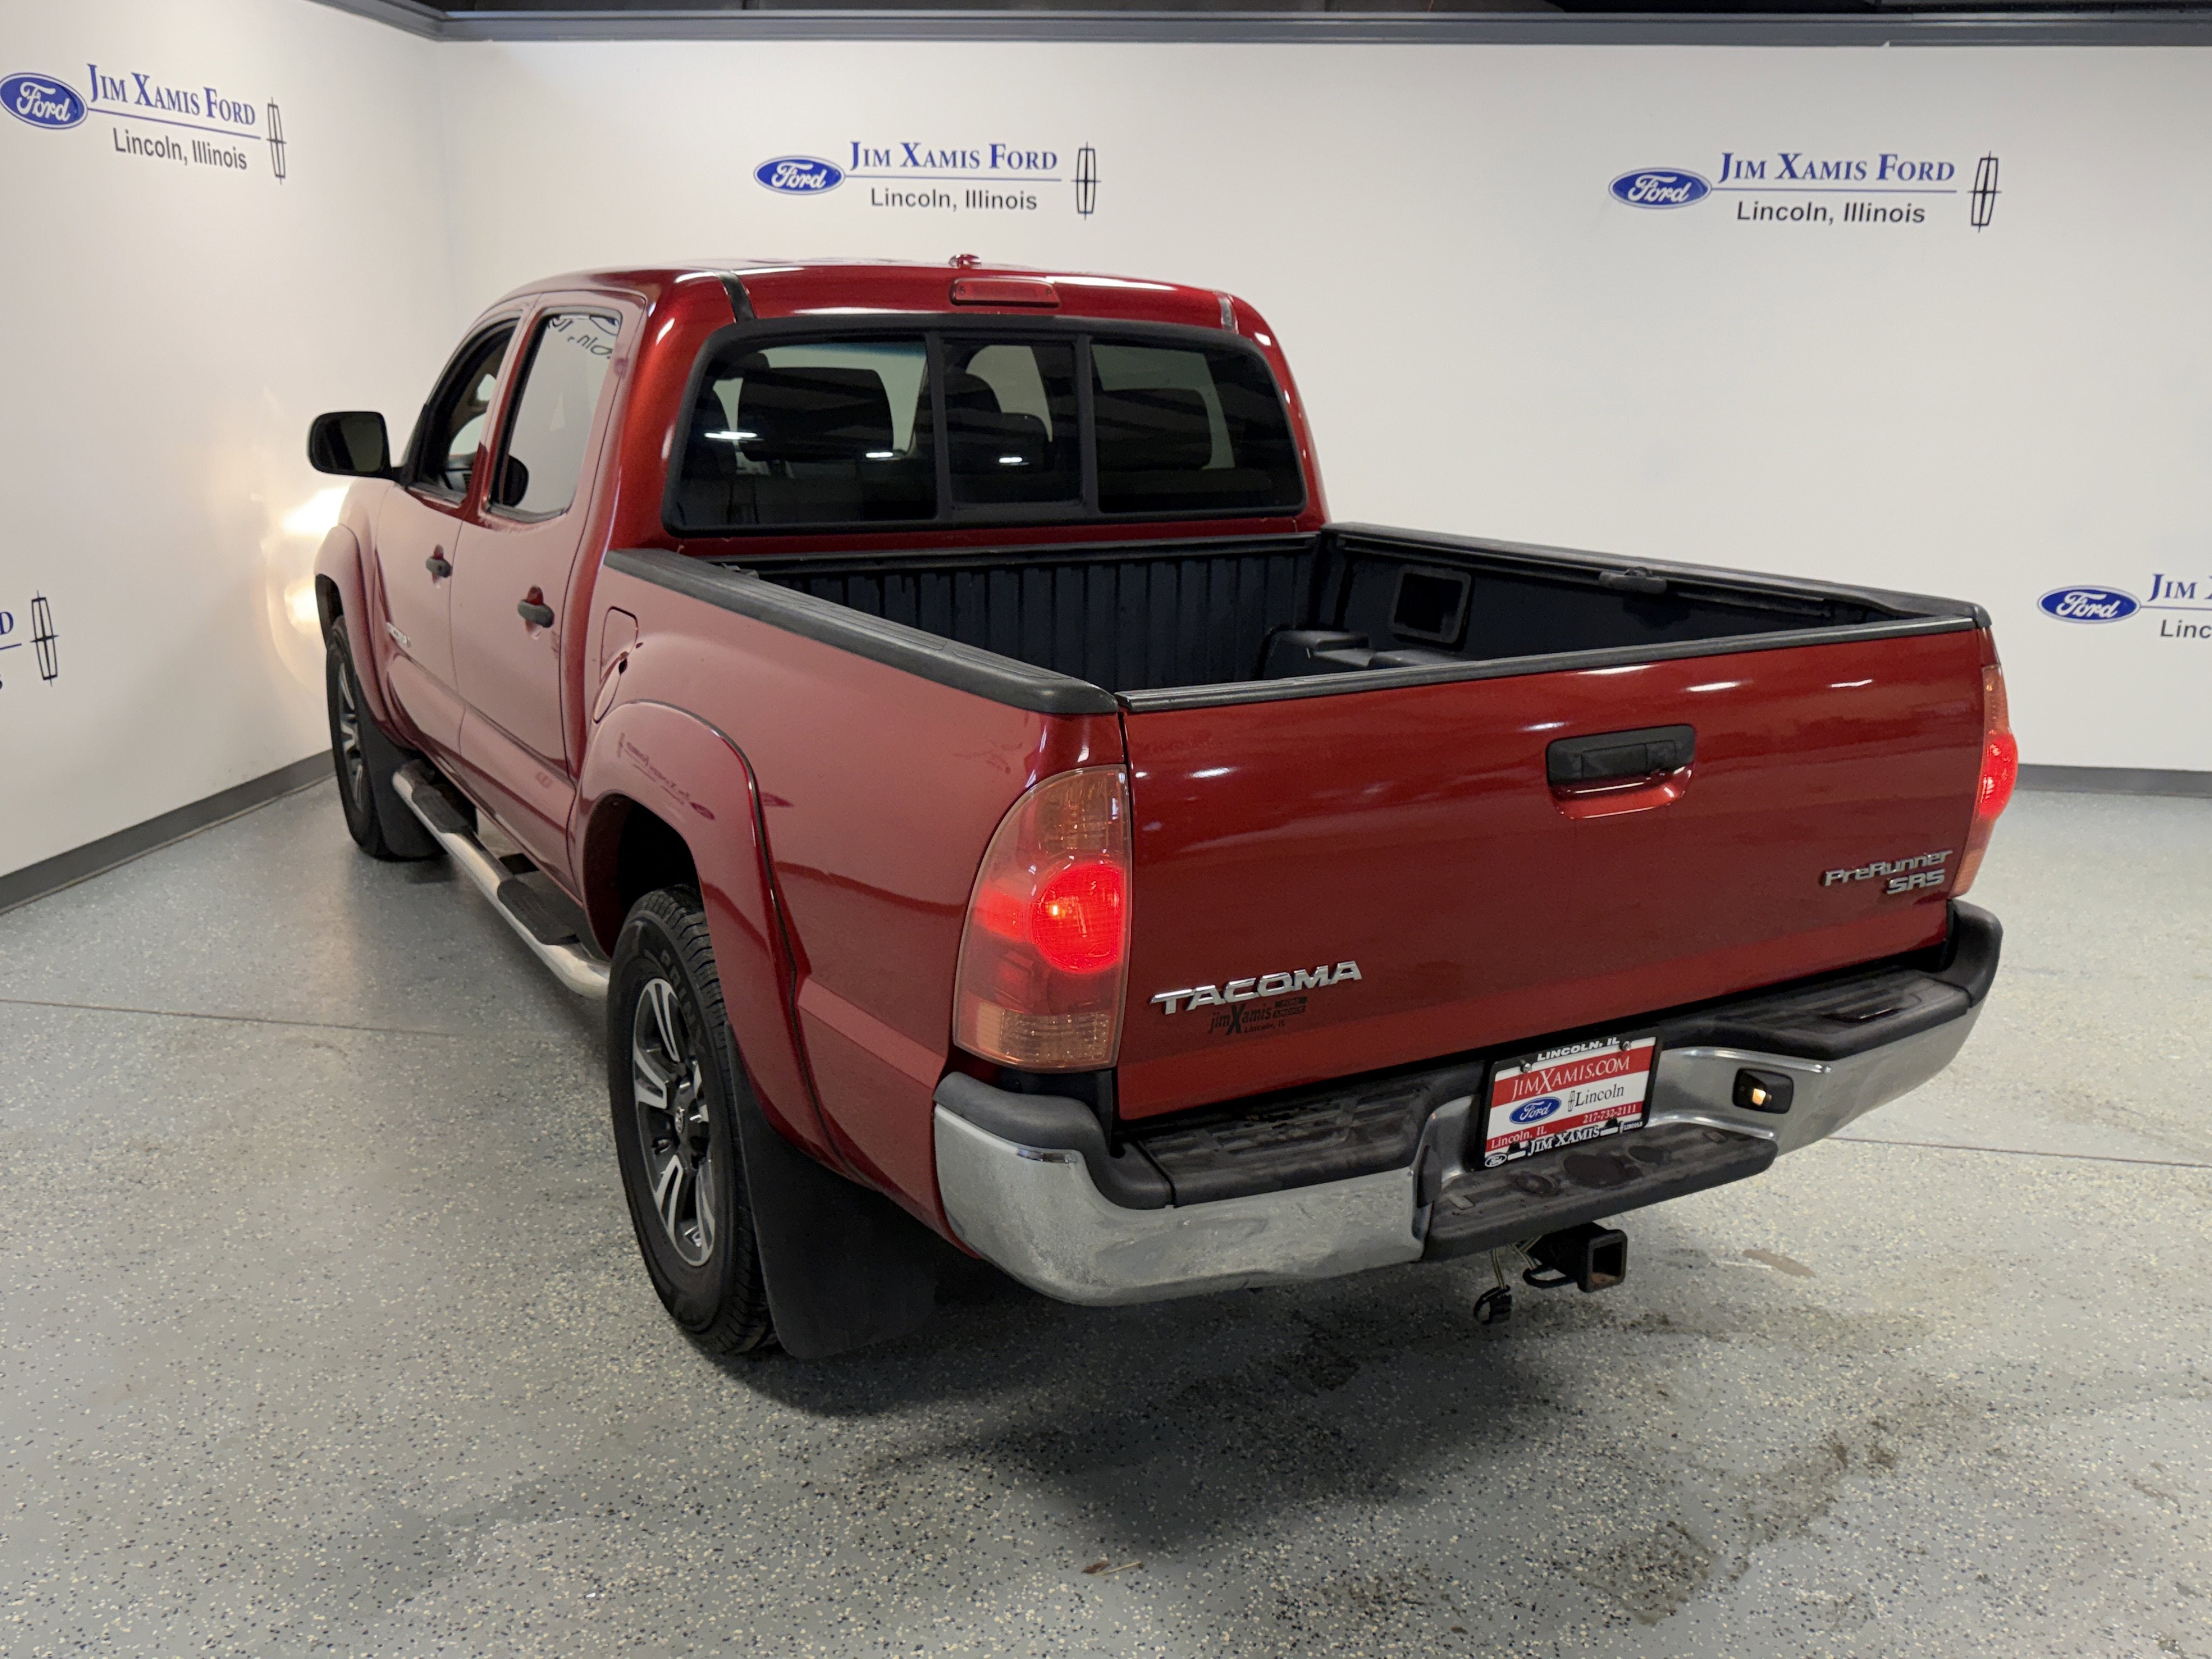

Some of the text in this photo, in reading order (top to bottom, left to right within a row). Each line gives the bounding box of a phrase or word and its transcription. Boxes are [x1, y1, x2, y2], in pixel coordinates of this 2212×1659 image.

[16, 81, 71, 122] Ford
[112, 128, 247, 170] Lincoln, Illinois
[771, 159, 826, 189] Ford
[871, 188, 1037, 211] Lincoln, Illinois
[1627, 175, 1690, 204] Ford
[1737, 201, 1926, 225] Lincoln, Illinois
[2056, 591, 2121, 619] Ford
[1824, 849, 1953, 887] PreRunner
[1886, 868, 1945, 895] SR5
[1150, 960, 1363, 1015] TACOMA
[1537, 1036, 1620, 1062] LINCOLN, IL
[1510, 1056, 1630, 1102] JIMXAMIS.COM
[1574, 1083, 1624, 1107] Lincoln
[1520, 1101, 1552, 1121] Ford
[1582, 1103, 1637, 1124] 217-732-2111
[1527, 1136, 1555, 1156] JIM
[1555, 1126, 1600, 1148] XAMIS
[1537, 1125, 1547, 1137] IL
